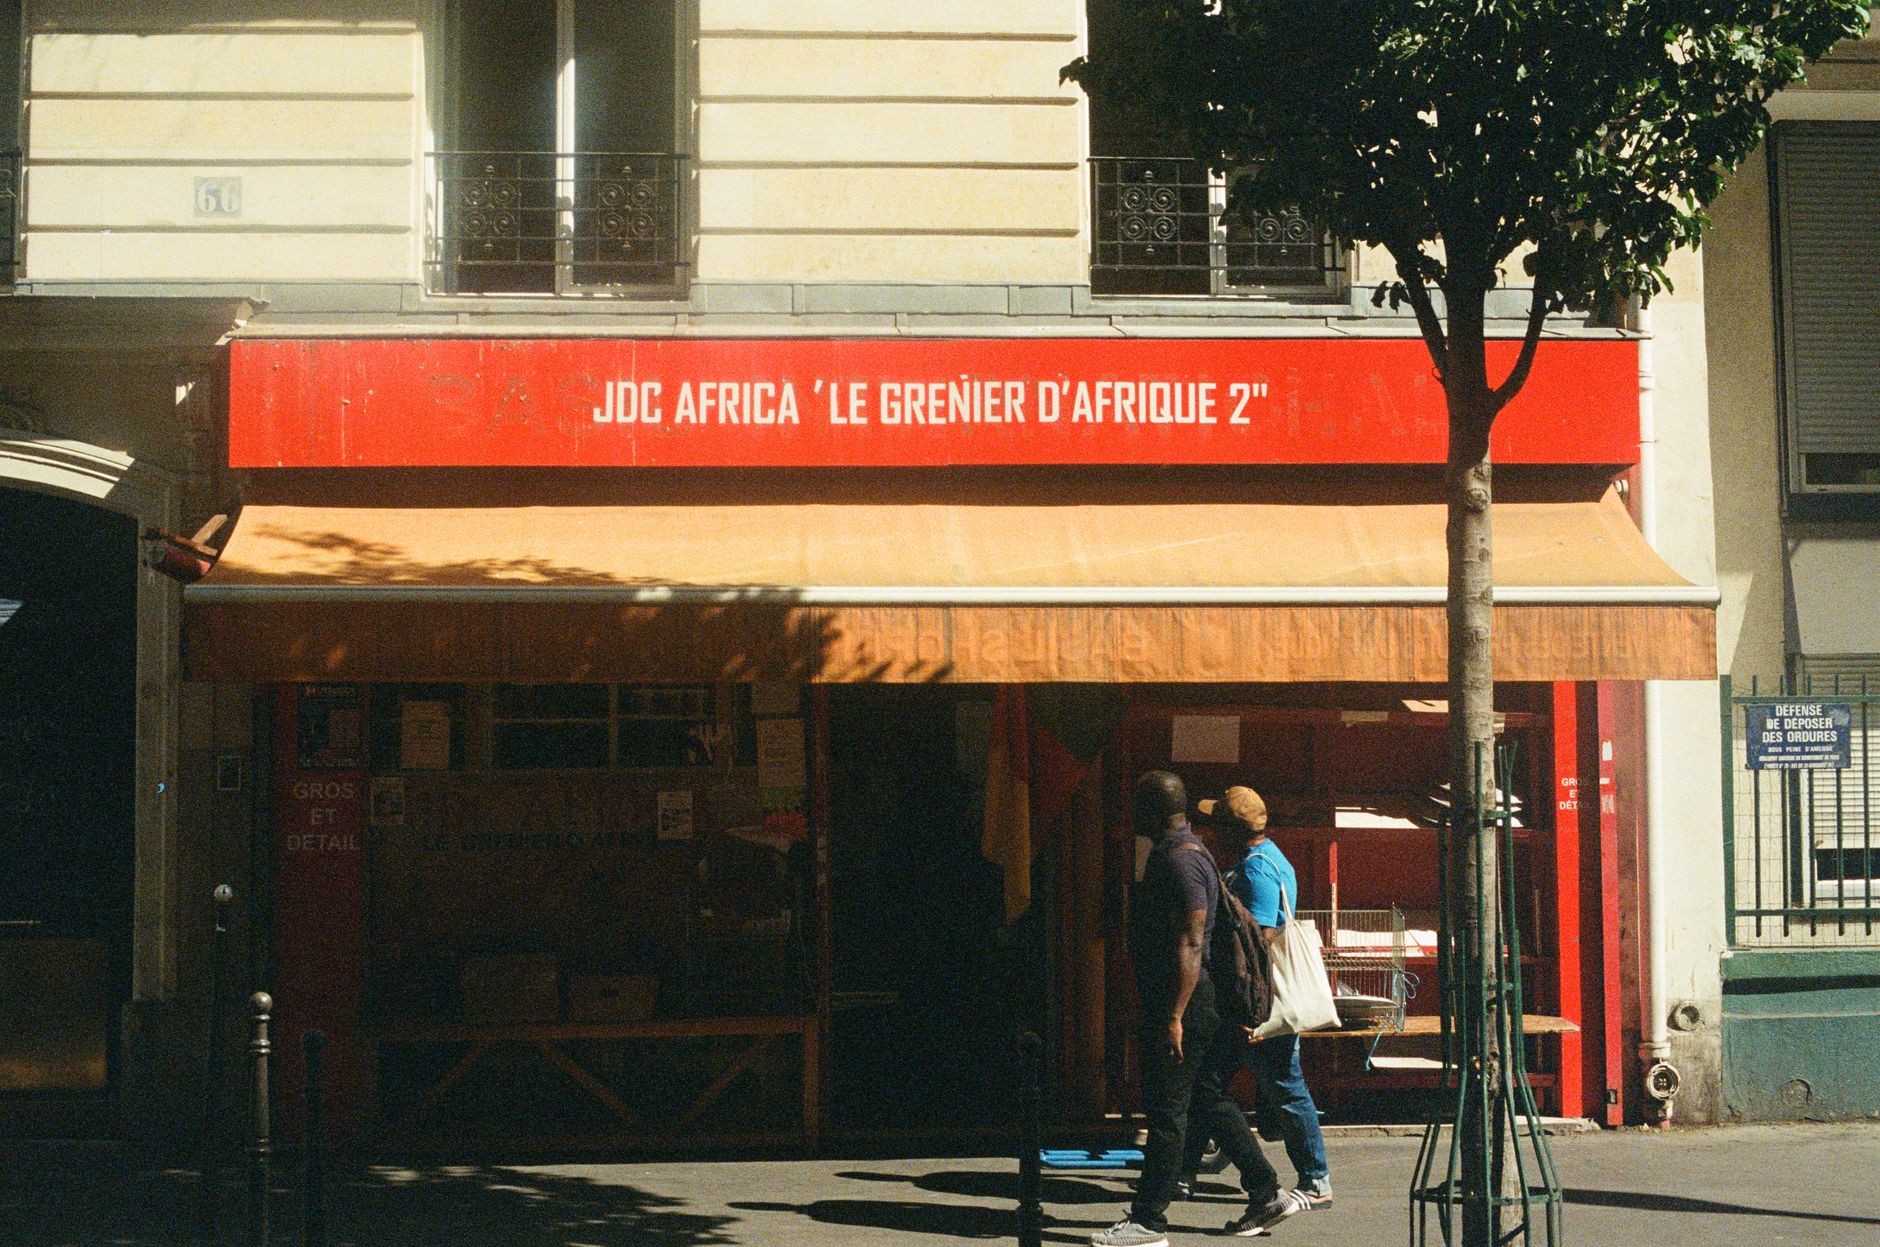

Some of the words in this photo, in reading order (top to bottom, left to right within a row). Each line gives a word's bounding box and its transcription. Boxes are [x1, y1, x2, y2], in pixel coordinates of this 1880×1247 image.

[593, 377, 661, 424] JDC
[675, 378, 799, 424] AFRICA
[880, 377, 1025, 425] GRENIER
[1039, 381, 1217, 424] D'AFRIQUE
[1230, 383, 1267, 424] 2"
[1766, 719, 1780, 729] DE
[1762, 732, 1783, 742] DES
[1787, 731, 1838, 742] ORDURES
[293, 782, 354, 800] GROS
[310, 808, 338, 826] ET
